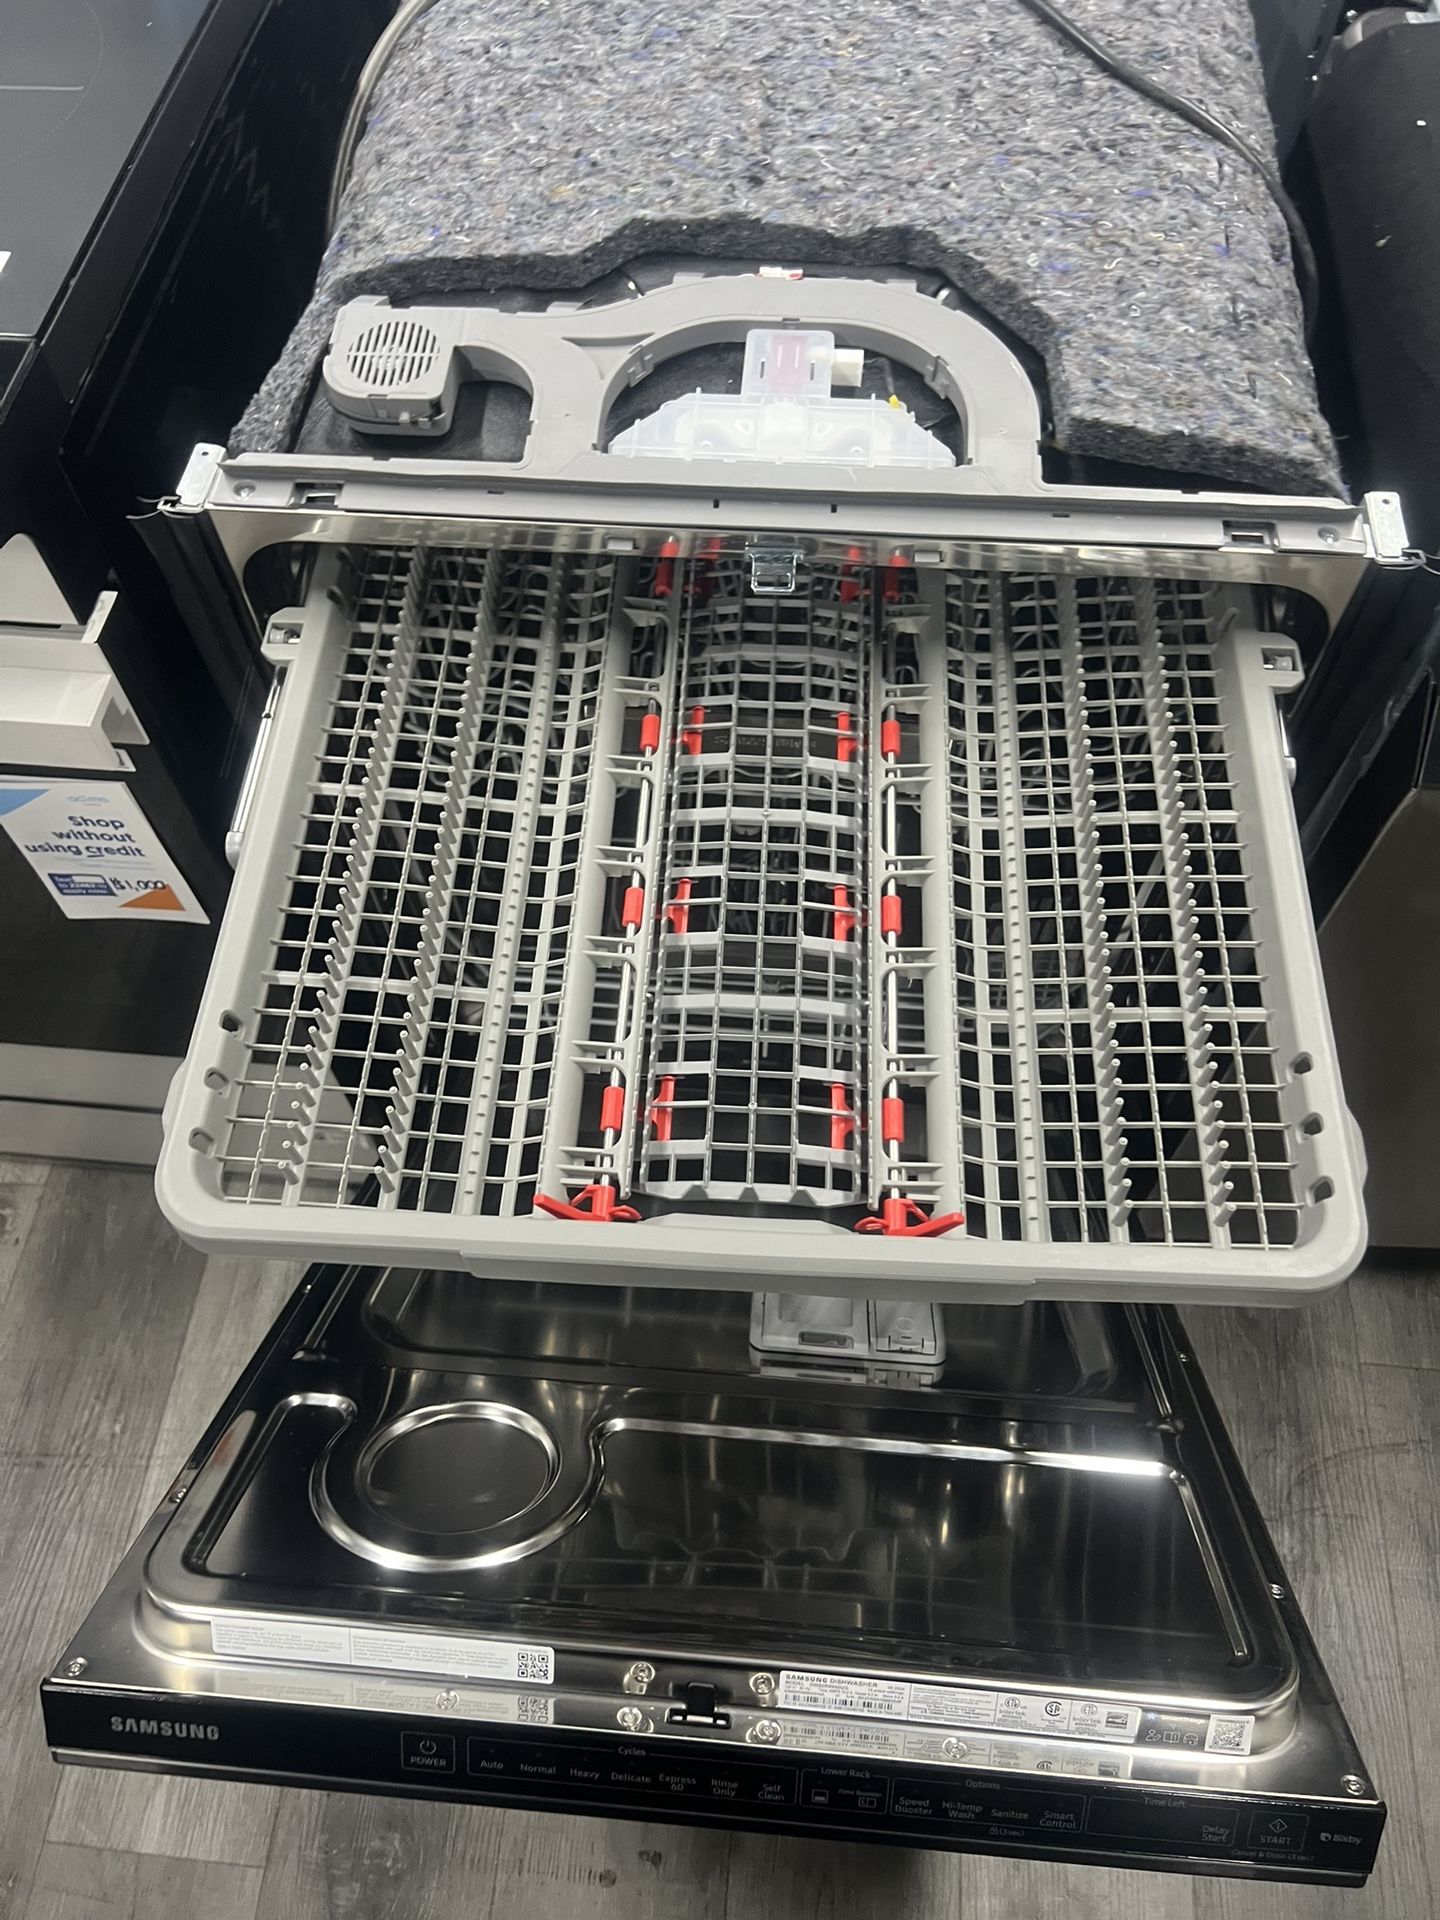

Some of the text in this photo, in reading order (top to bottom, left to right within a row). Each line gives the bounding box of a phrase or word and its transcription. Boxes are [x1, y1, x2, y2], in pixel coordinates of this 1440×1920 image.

[68, 815, 125, 830] Shop
[52, 829, 136, 843] without
[25, 842, 146, 857] using credit
[786, 1673, 828, 1684] SAMSUNG
[829, 1678, 878, 1689] DISHWASHER
[110, 1715, 220, 1741] SAMSUNG
[617, 1746, 647, 1757] Cycles
[410, 1756, 447, 1767] POWER
[480, 1759, 504, 1770] Auto
[519, 1763, 557, 1774] Normal
[569, 1767, 600, 1781] Heavy
[820, 1766, 871, 1778] Lower Rack
[611, 1771, 652, 1783] Delicate
[658, 1773, 697, 1786] Express
[670, 1783, 685, 1792] 60
[711, 1778, 739, 1789] Rinse
[762, 1783, 782, 1793] Self
[965, 1778, 1001, 1791] Options
[713, 1787, 737, 1799] Only
[758, 1791, 785, 1801] Clean
[898, 1796, 930, 1808] Speed
[942, 1800, 983, 1813] Hi-Temp
[1144, 1797, 1187, 1808] Time Left
[894, 1804, 933, 1815] Booster
[949, 1809, 975, 1820] Wash
[991, 1808, 1029, 1820] Sanitize
[1044, 1810, 1075, 1821] Smart
[1040, 1818, 1077, 1830] Control
[1201, 1824, 1230, 1835] Delay
[1201, 1833, 1227, 1843] Start
[1259, 1835, 1293, 1845] START
[1332, 1834, 1363, 1846] Bixby
